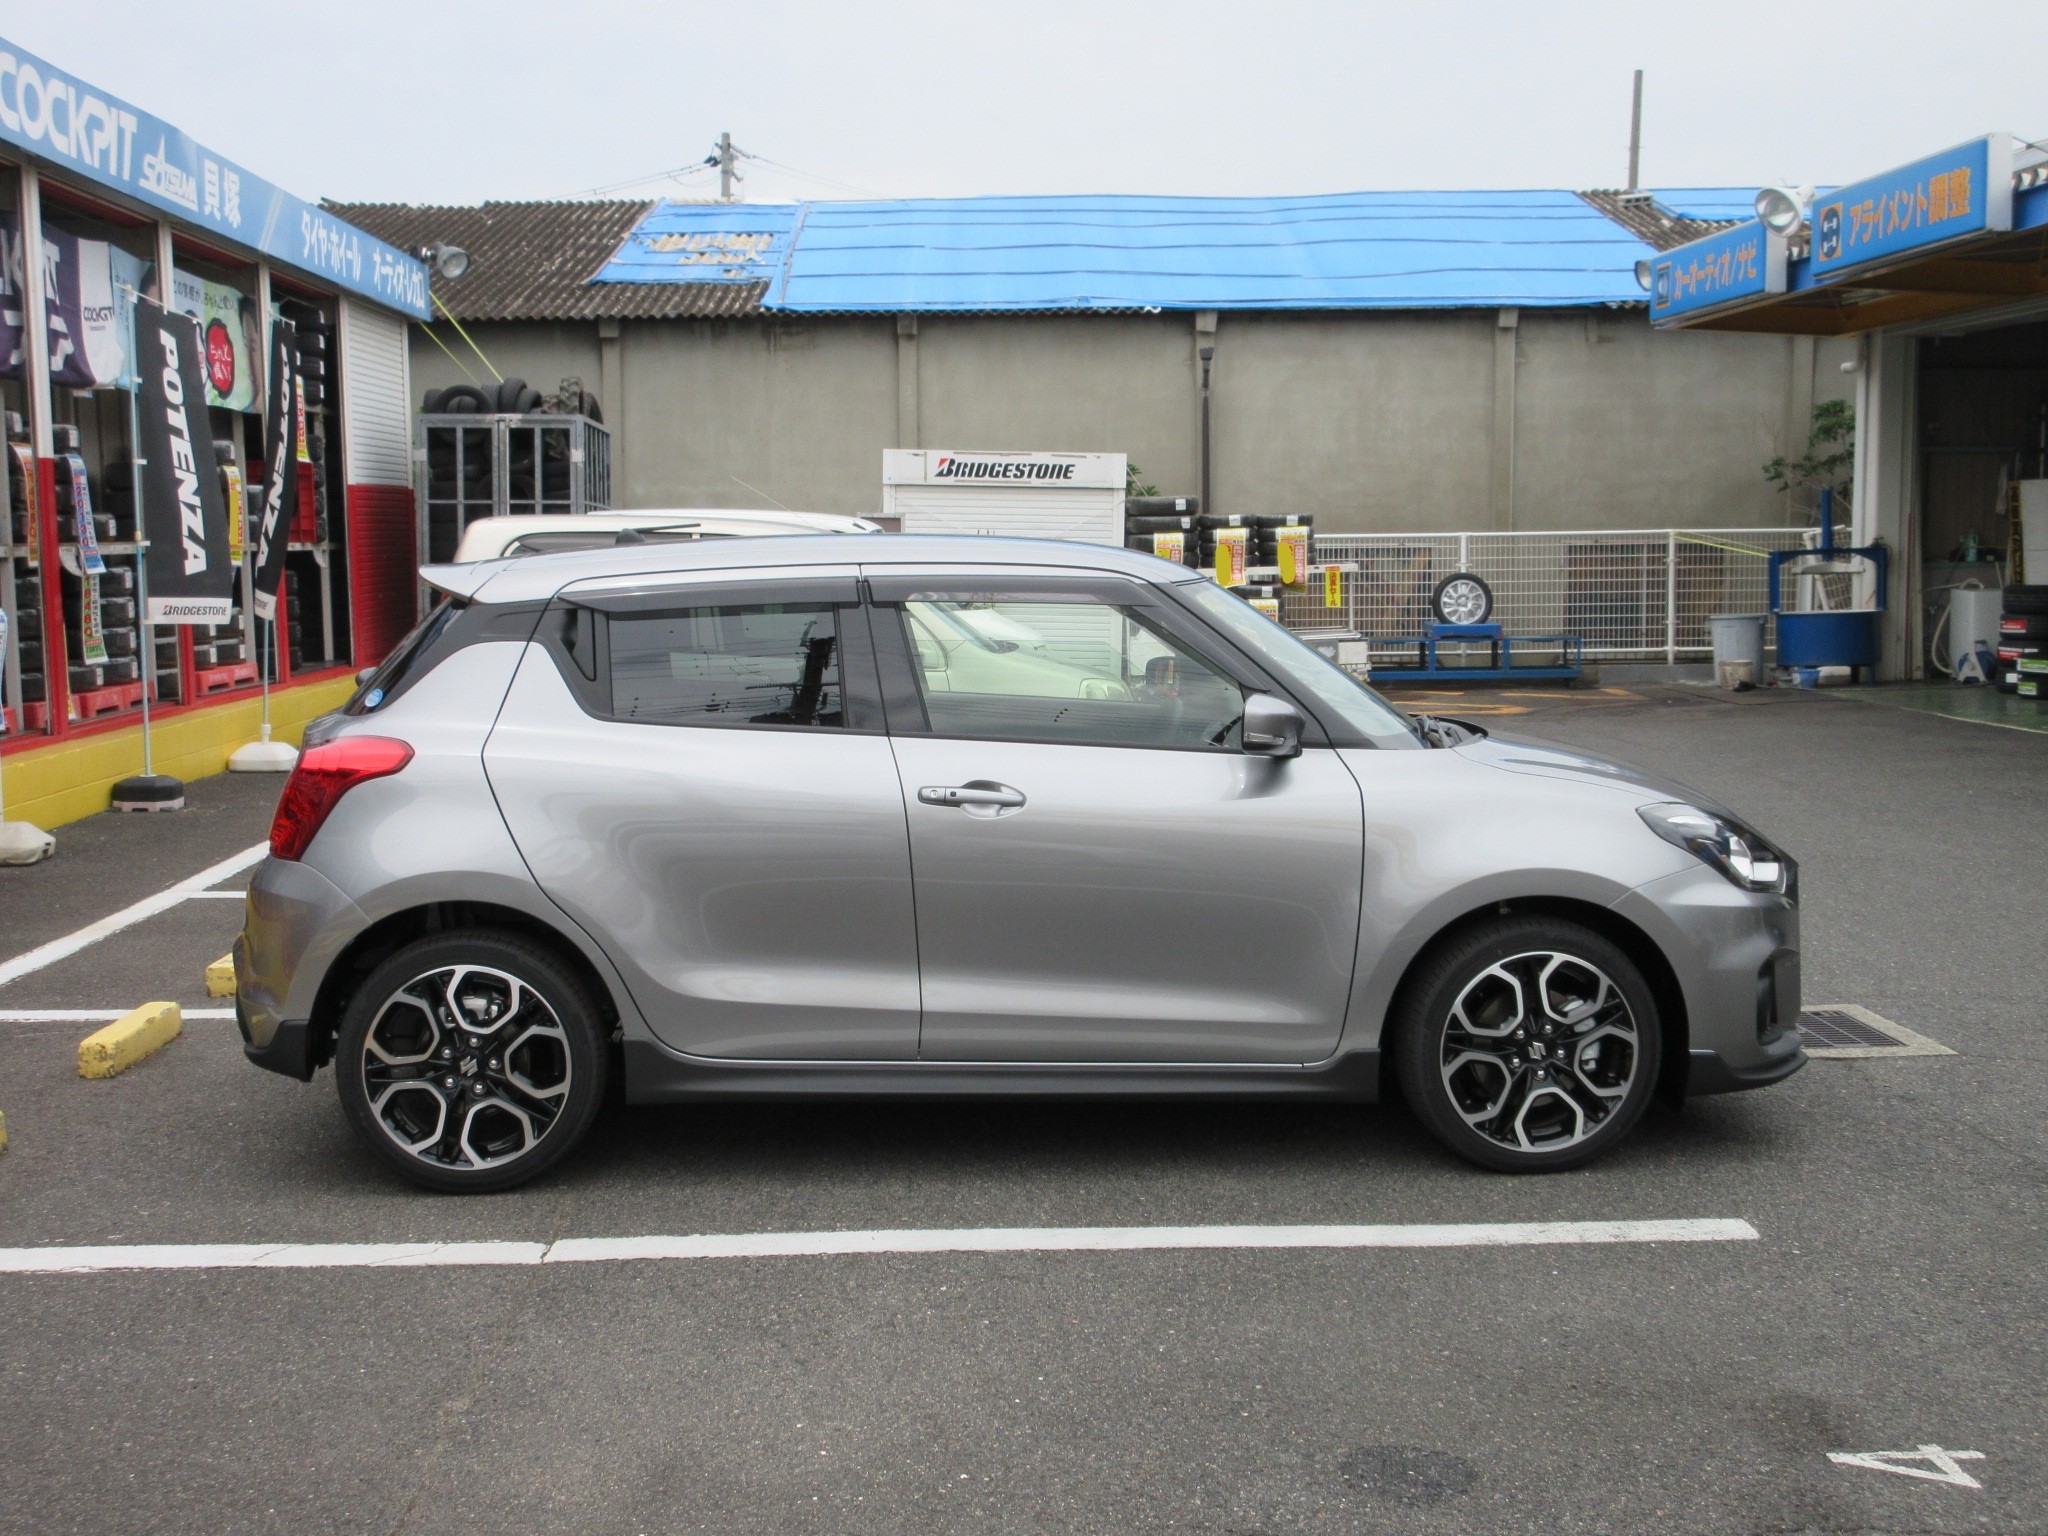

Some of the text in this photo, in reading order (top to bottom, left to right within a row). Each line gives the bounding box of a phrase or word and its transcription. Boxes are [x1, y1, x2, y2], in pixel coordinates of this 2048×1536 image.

[0, 51, 137, 182] COCKPIT
[203, 158, 241, 229] 貝塚
[1848, 166, 1971, 247] アライメント調整
[159, 328, 207, 576] POTENZA
[934, 457, 1076, 480] BRIDGESTONE
[162, 604, 227, 616] BRIDGESTONE
